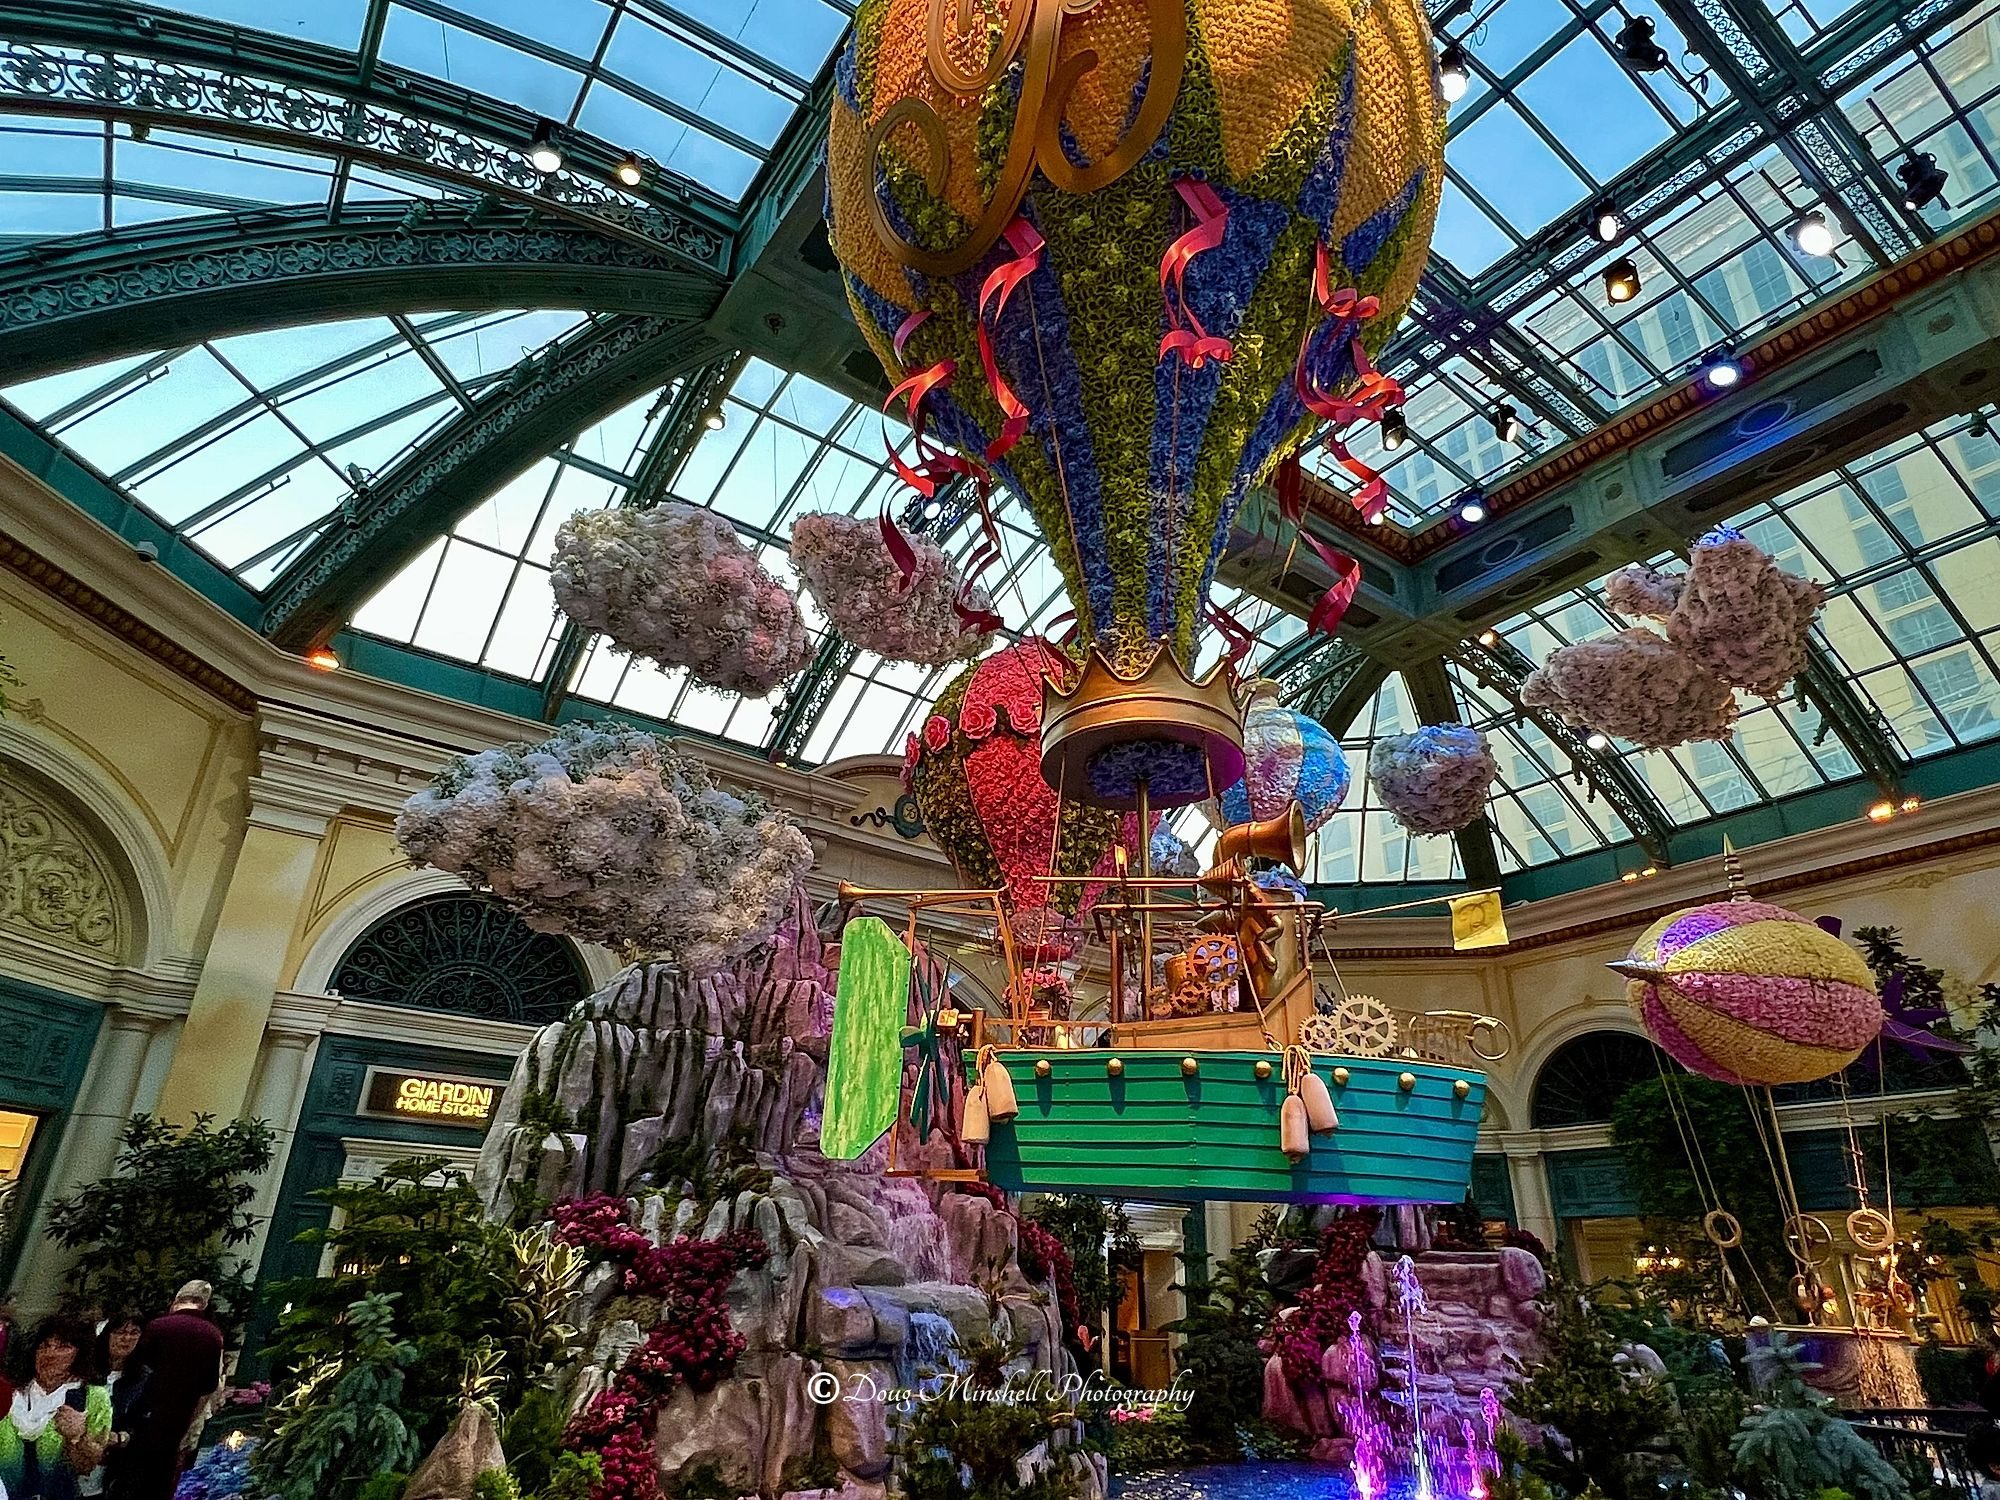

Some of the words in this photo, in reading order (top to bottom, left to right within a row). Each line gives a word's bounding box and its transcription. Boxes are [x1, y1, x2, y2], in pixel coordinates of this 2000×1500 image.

[400, 1078, 494, 1106] GIARDINI
[395, 1096, 442, 1114] HOME
[441, 1101, 489, 1118] STORE
